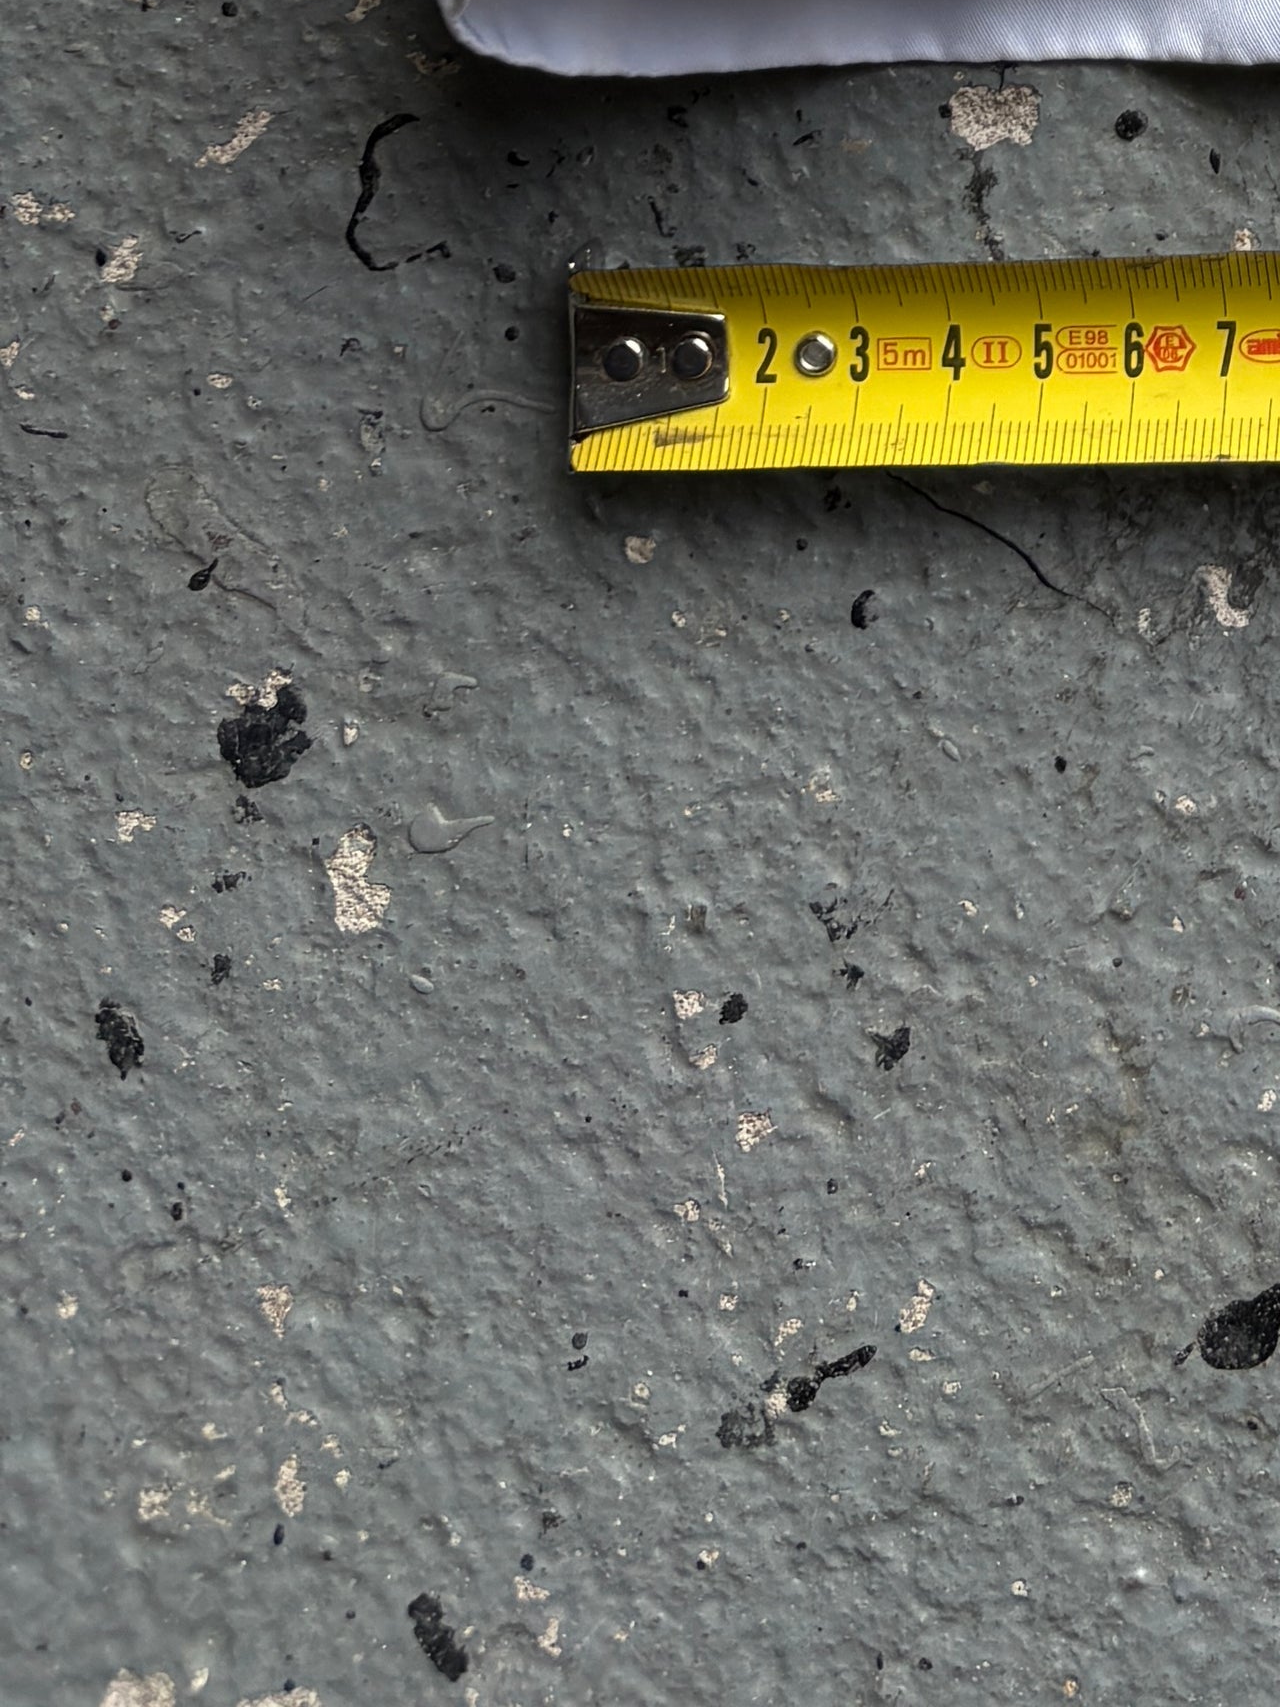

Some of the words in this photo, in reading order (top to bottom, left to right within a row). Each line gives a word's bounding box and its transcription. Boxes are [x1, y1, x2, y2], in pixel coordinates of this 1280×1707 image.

[756, 327, 777, 384] 2
[850, 325, 870, 382] 3
[942, 324, 966, 381] 4
[1034, 323, 1054, 379] 5
[1125, 322, 1144, 378] 6
[1217, 321, 1237, 377] 7
[983, 341, 1008, 364] II
[1066, 352, 1117, 369] 01001
